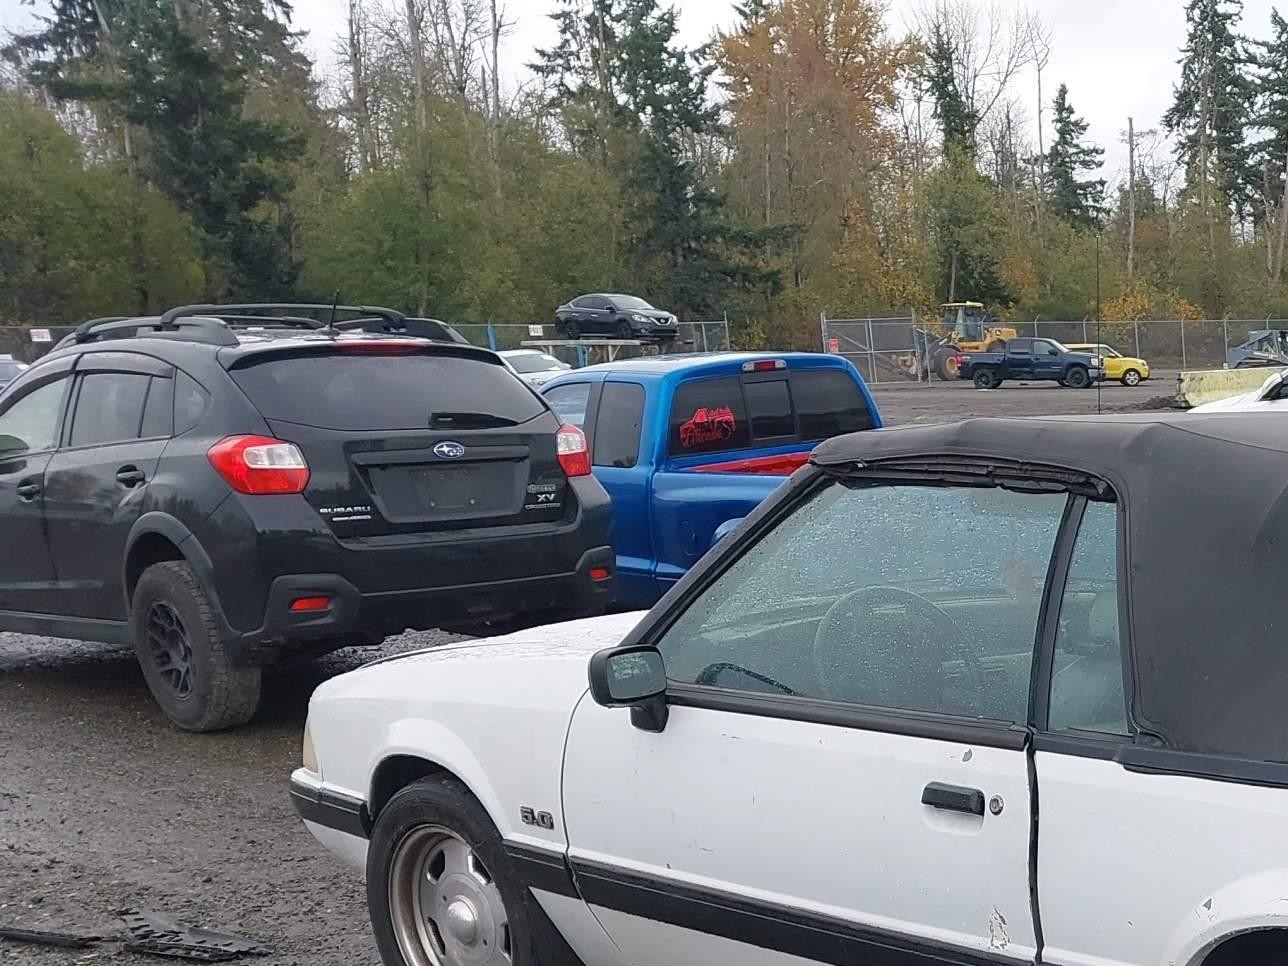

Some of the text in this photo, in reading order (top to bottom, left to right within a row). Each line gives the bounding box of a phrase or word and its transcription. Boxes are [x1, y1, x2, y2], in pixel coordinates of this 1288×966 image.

[536, 493, 556, 503] XV
[319, 505, 371, 514] SUBARU
[519, 805, 555, 831] 5.0
